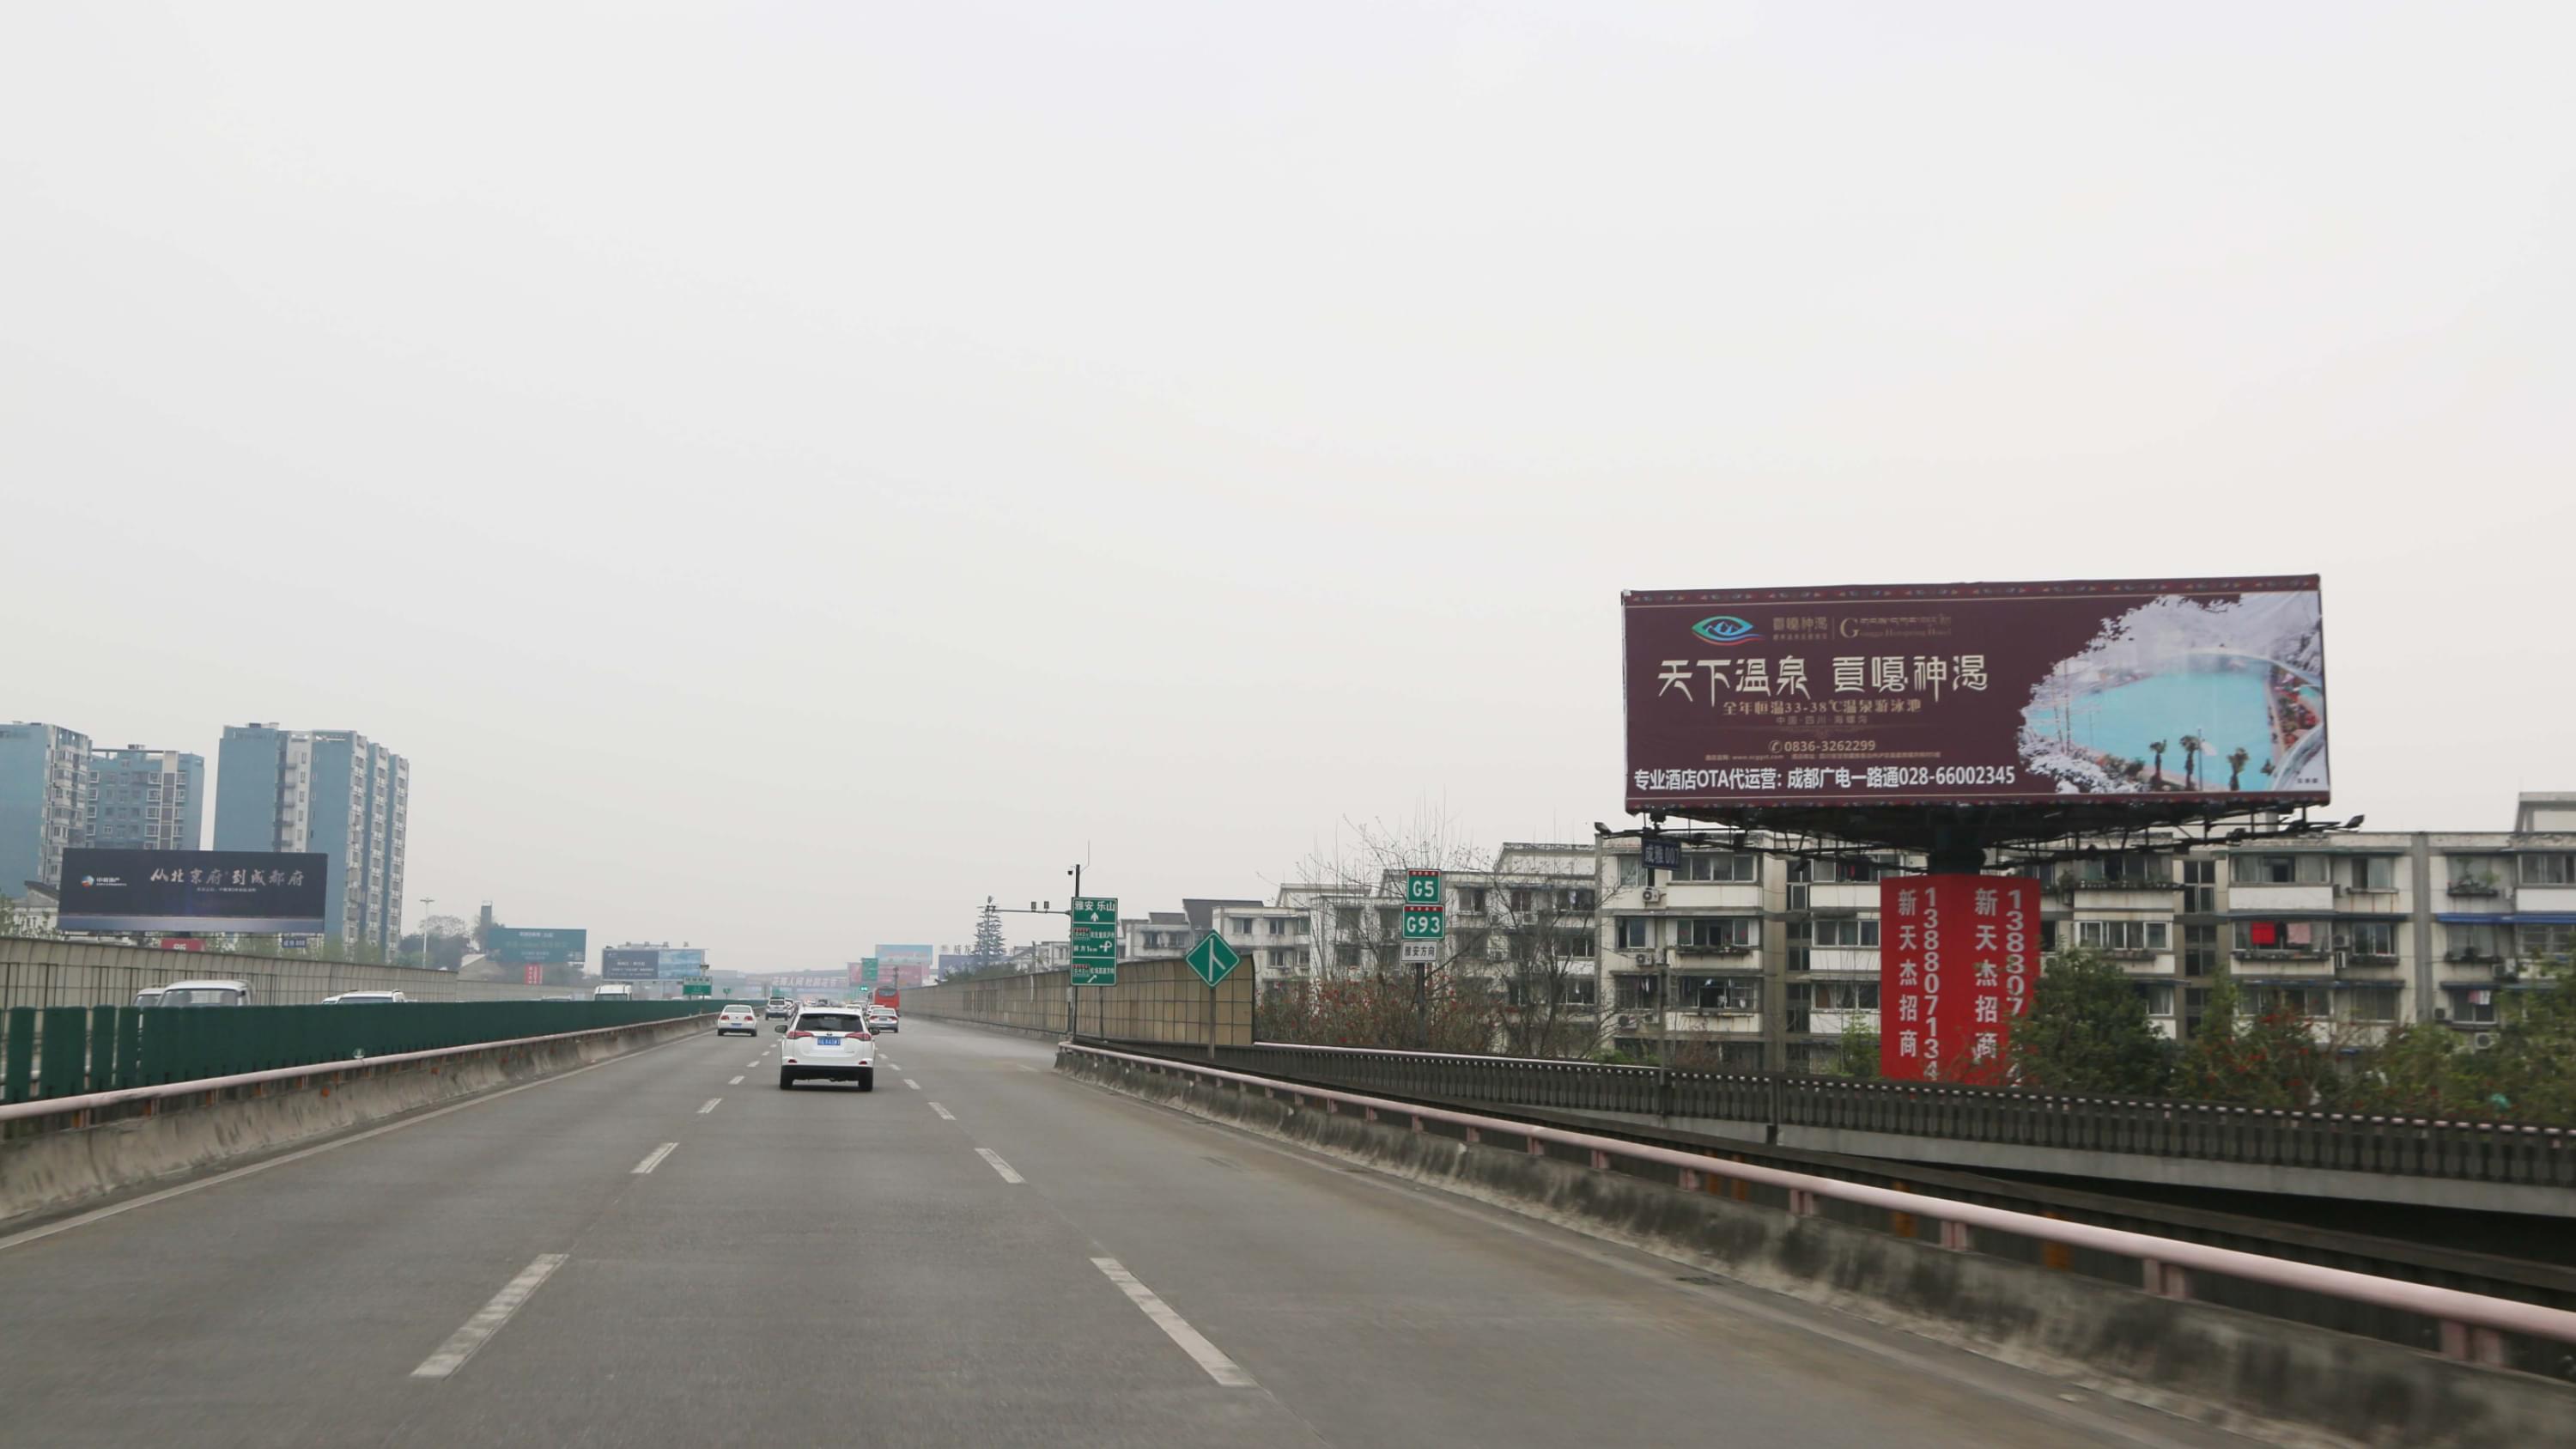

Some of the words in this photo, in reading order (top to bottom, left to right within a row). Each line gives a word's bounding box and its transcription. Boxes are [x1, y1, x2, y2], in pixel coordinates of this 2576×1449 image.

[1657, 655, 1811, 707] 天下温泉
[1783, 740, 1876, 752] 0836-3262299
[1413, 880, 1435, 898] G5
[1075, 900, 1093, 910] 雅安
[1097, 900, 1115, 911] 乐山
[1406, 916, 1441, 934] G93
[1405, 946, 1435, 957] 雅安方向
[1899, 888, 1918, 1057] 新天杰招商
[1975, 888, 1998, 1059] 新天杰招商
